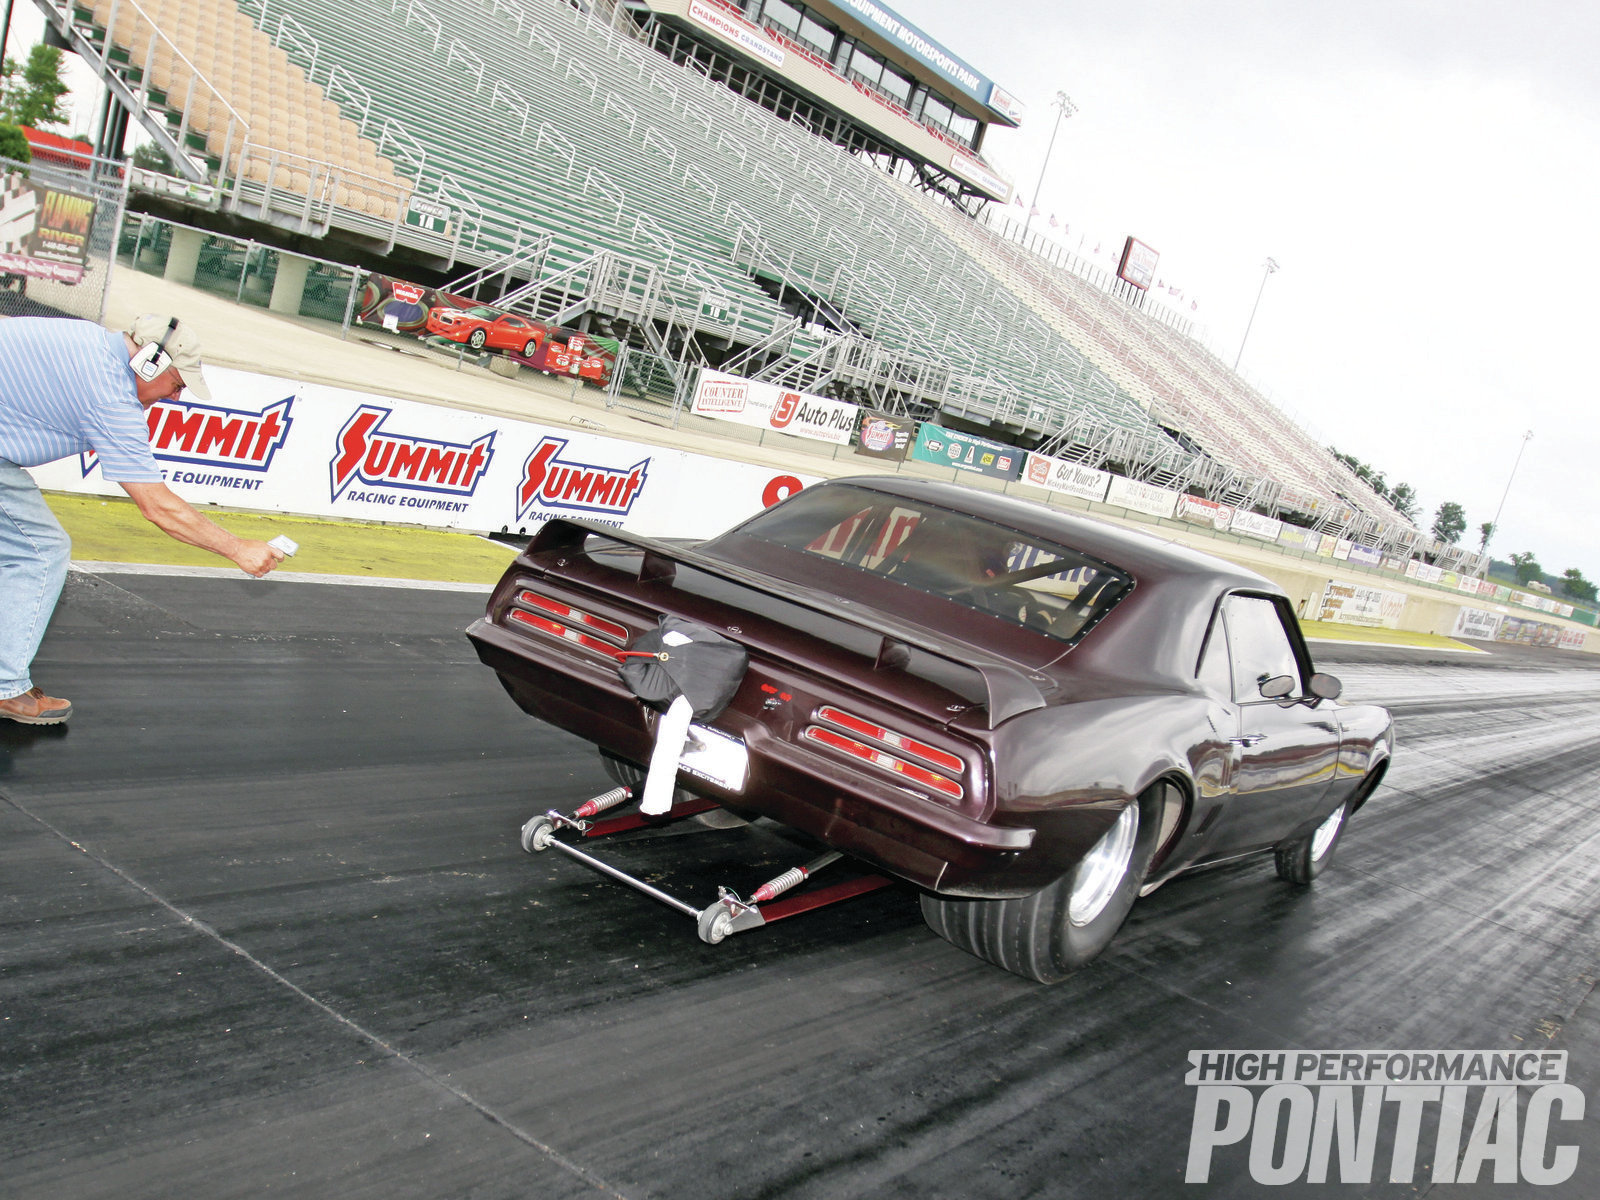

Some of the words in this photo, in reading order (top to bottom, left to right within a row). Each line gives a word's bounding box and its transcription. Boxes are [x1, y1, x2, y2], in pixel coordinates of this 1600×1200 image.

[692, 6, 739, 38] CHAMPIONS
[741, 34, 783, 63] GRANDSTAND
[842, 0, 900, 34] QUIPMENT
[896, 24, 959, 77] MOTORSPORTS
[957, 66, 980, 91] PARK
[419, 214, 434, 230] 1A
[38, 227, 85, 246] RIVER
[710, 306, 720, 318] 1B
[704, 387, 744, 399] COUNTER
[795, 401, 828, 427] Auto
[828, 408, 854, 432] Plus
[172, 471, 263, 490] EQUIPMENT
[1056, 463, 1074, 481] Got
[1073, 467, 1102, 488] Yours?
[347, 490, 397, 506] RACING
[399, 496, 469, 513] EQUIPMENT
